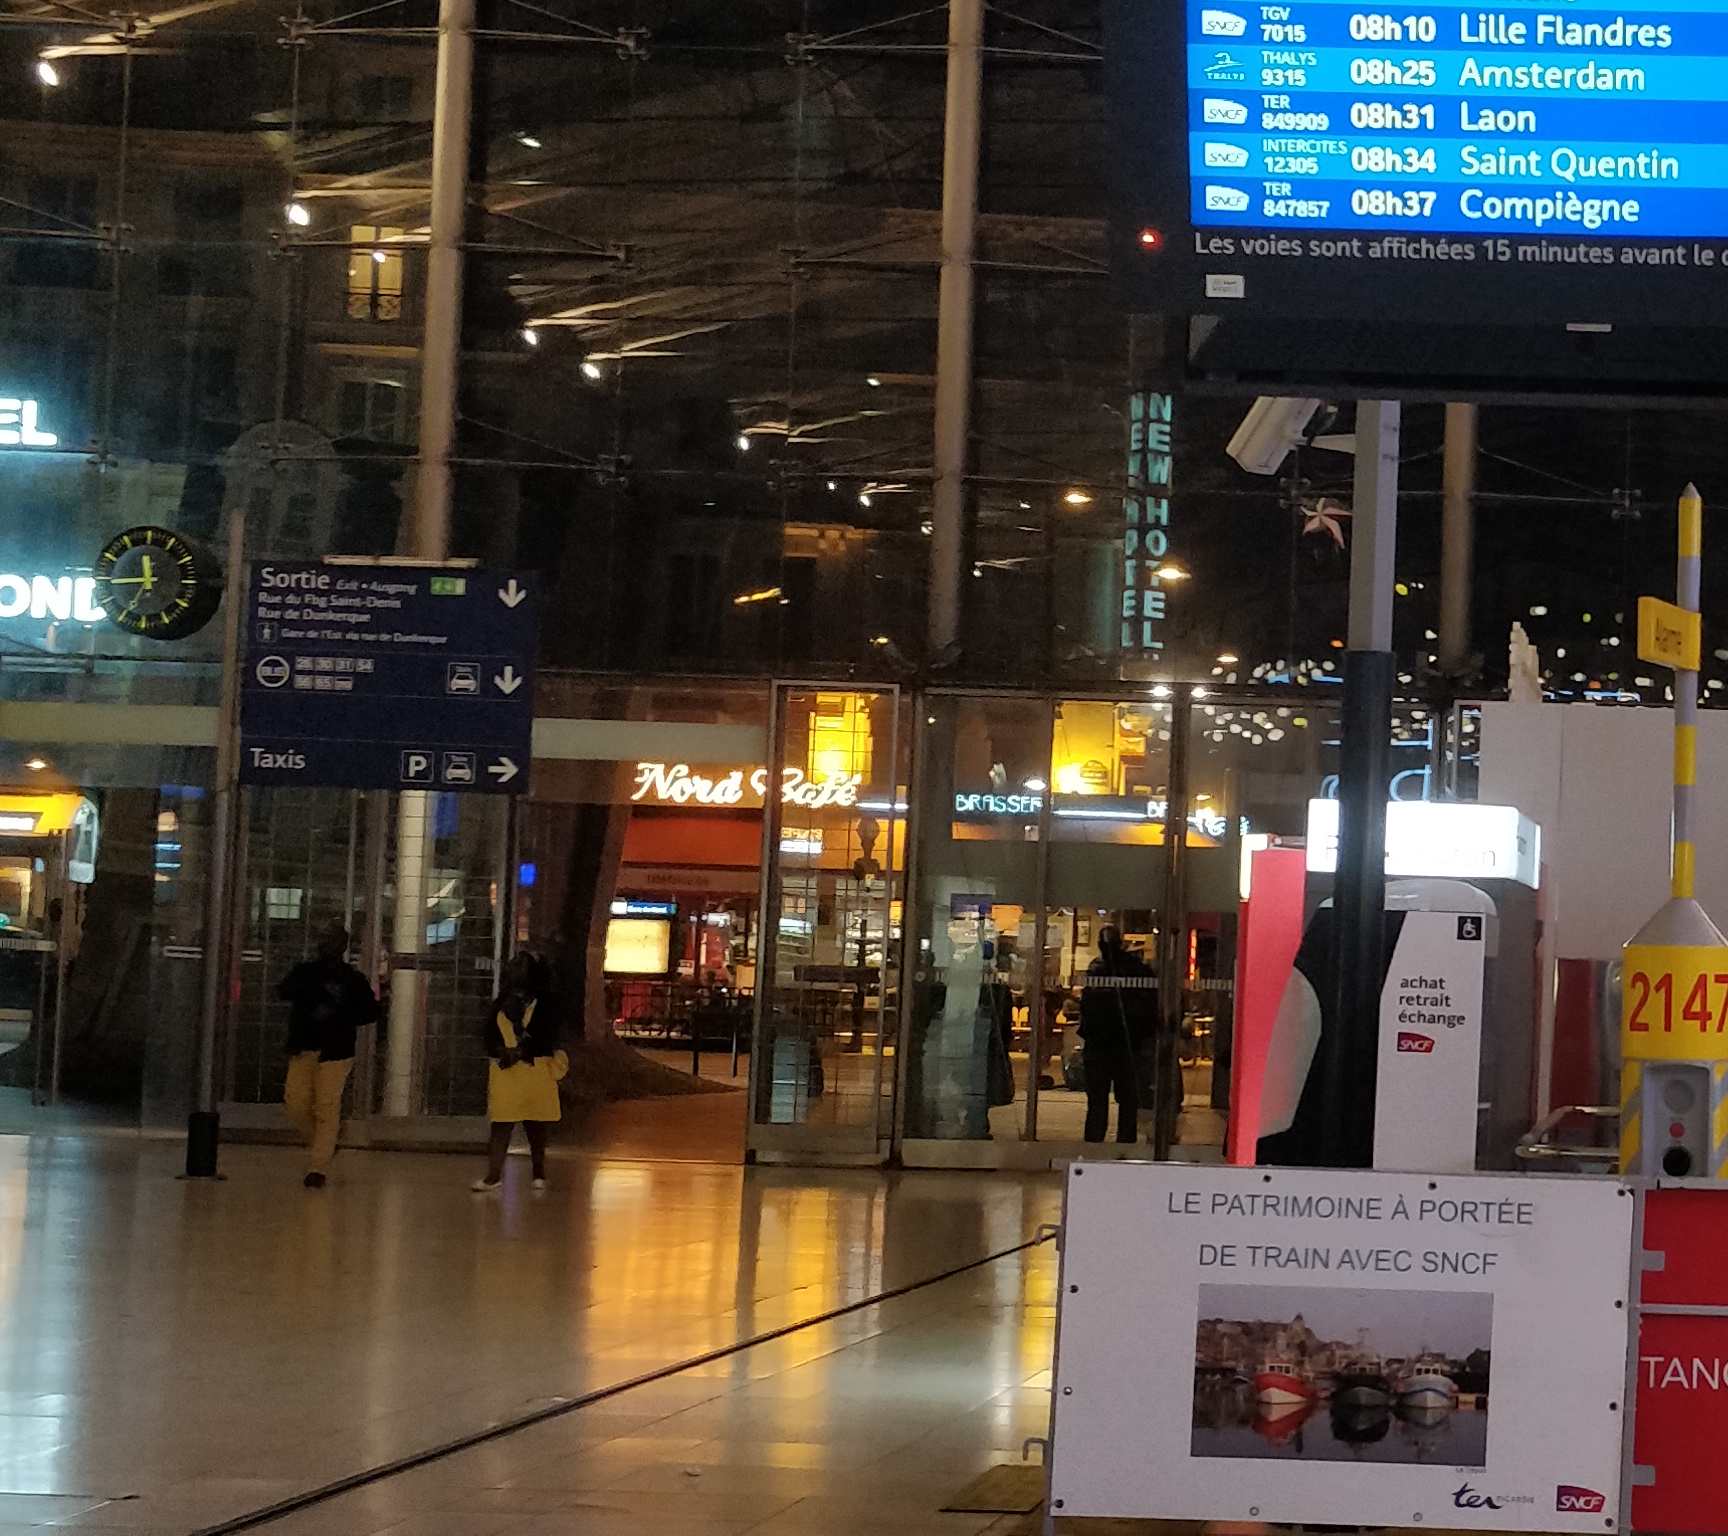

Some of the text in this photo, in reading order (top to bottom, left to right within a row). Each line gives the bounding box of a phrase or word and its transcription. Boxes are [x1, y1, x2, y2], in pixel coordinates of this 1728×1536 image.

[1349, 13, 1672, 49] 08h10 Lille Flandres
[1350, 58, 1645, 92] 08h25 Amsterdam
[1350, 101, 1537, 133] 08h31 Laon
[1351, 146, 1679, 184] 08h34 Saint Quentin
[1351, 190, 1640, 229] 08h37 Compiègne
[260, 567, 330, 590] Sortie
[258, 592, 282, 604] Rue
[250, 747, 306, 769] Taxis
[631, 762, 744, 804] Nord
[1400, 975, 1446, 990] achat
[1399, 993, 1451, 1007] retrait
[1399, 1009, 1466, 1028] échange
[1398, 1039, 1433, 1051] SNCF
[1168, 1192, 1534, 1225] LE PATRIMOINE À PORTÉE
[1199, 1245, 1499, 1275] DE TRAIN AVEC SNCF
[1558, 1496, 1603, 1510] SNCF
